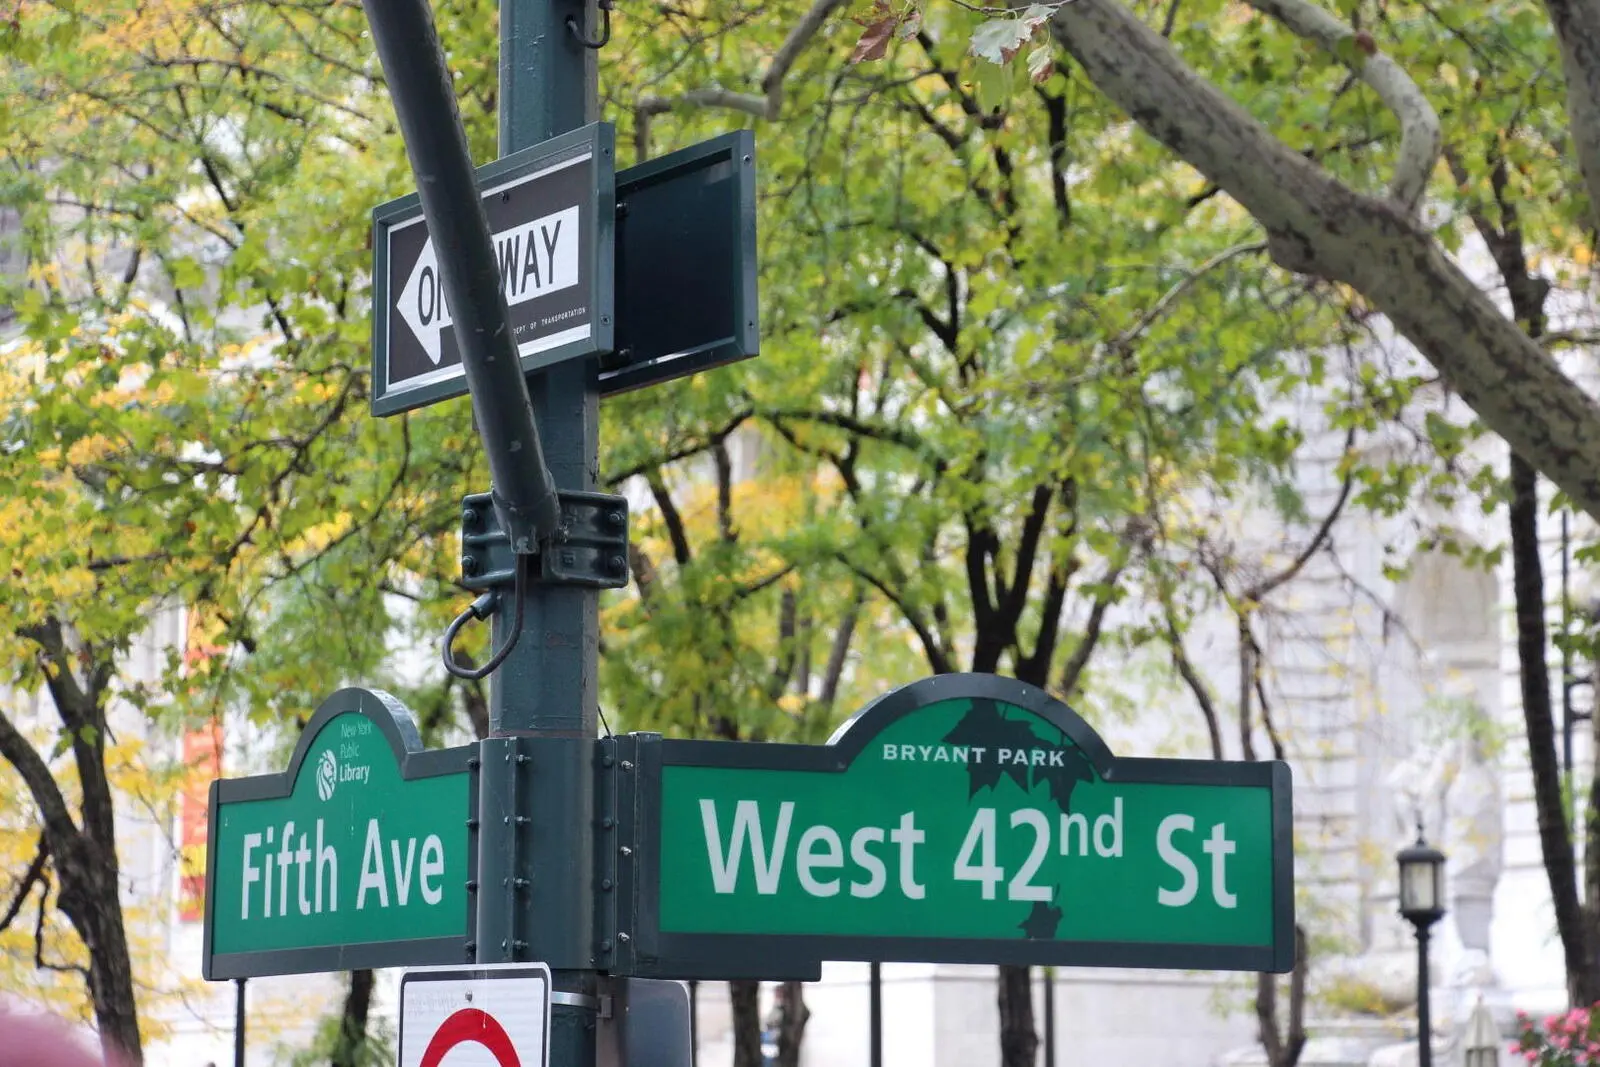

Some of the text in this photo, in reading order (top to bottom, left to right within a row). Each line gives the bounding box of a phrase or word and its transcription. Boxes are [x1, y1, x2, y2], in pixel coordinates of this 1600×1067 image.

[418, 220, 562, 326] ON WAY
[529, 321, 537, 330] OF
[541, 307, 586, 326] TRANSPORTATION
[341, 719, 372, 738] New York
[340, 741, 360, 759] Public
[882, 743, 1065, 767] BRYANT PARK
[339, 762, 370, 784] Library
[699, 797, 1238, 909] West 42nd St
[241, 818, 445, 921] Fifth Ave
